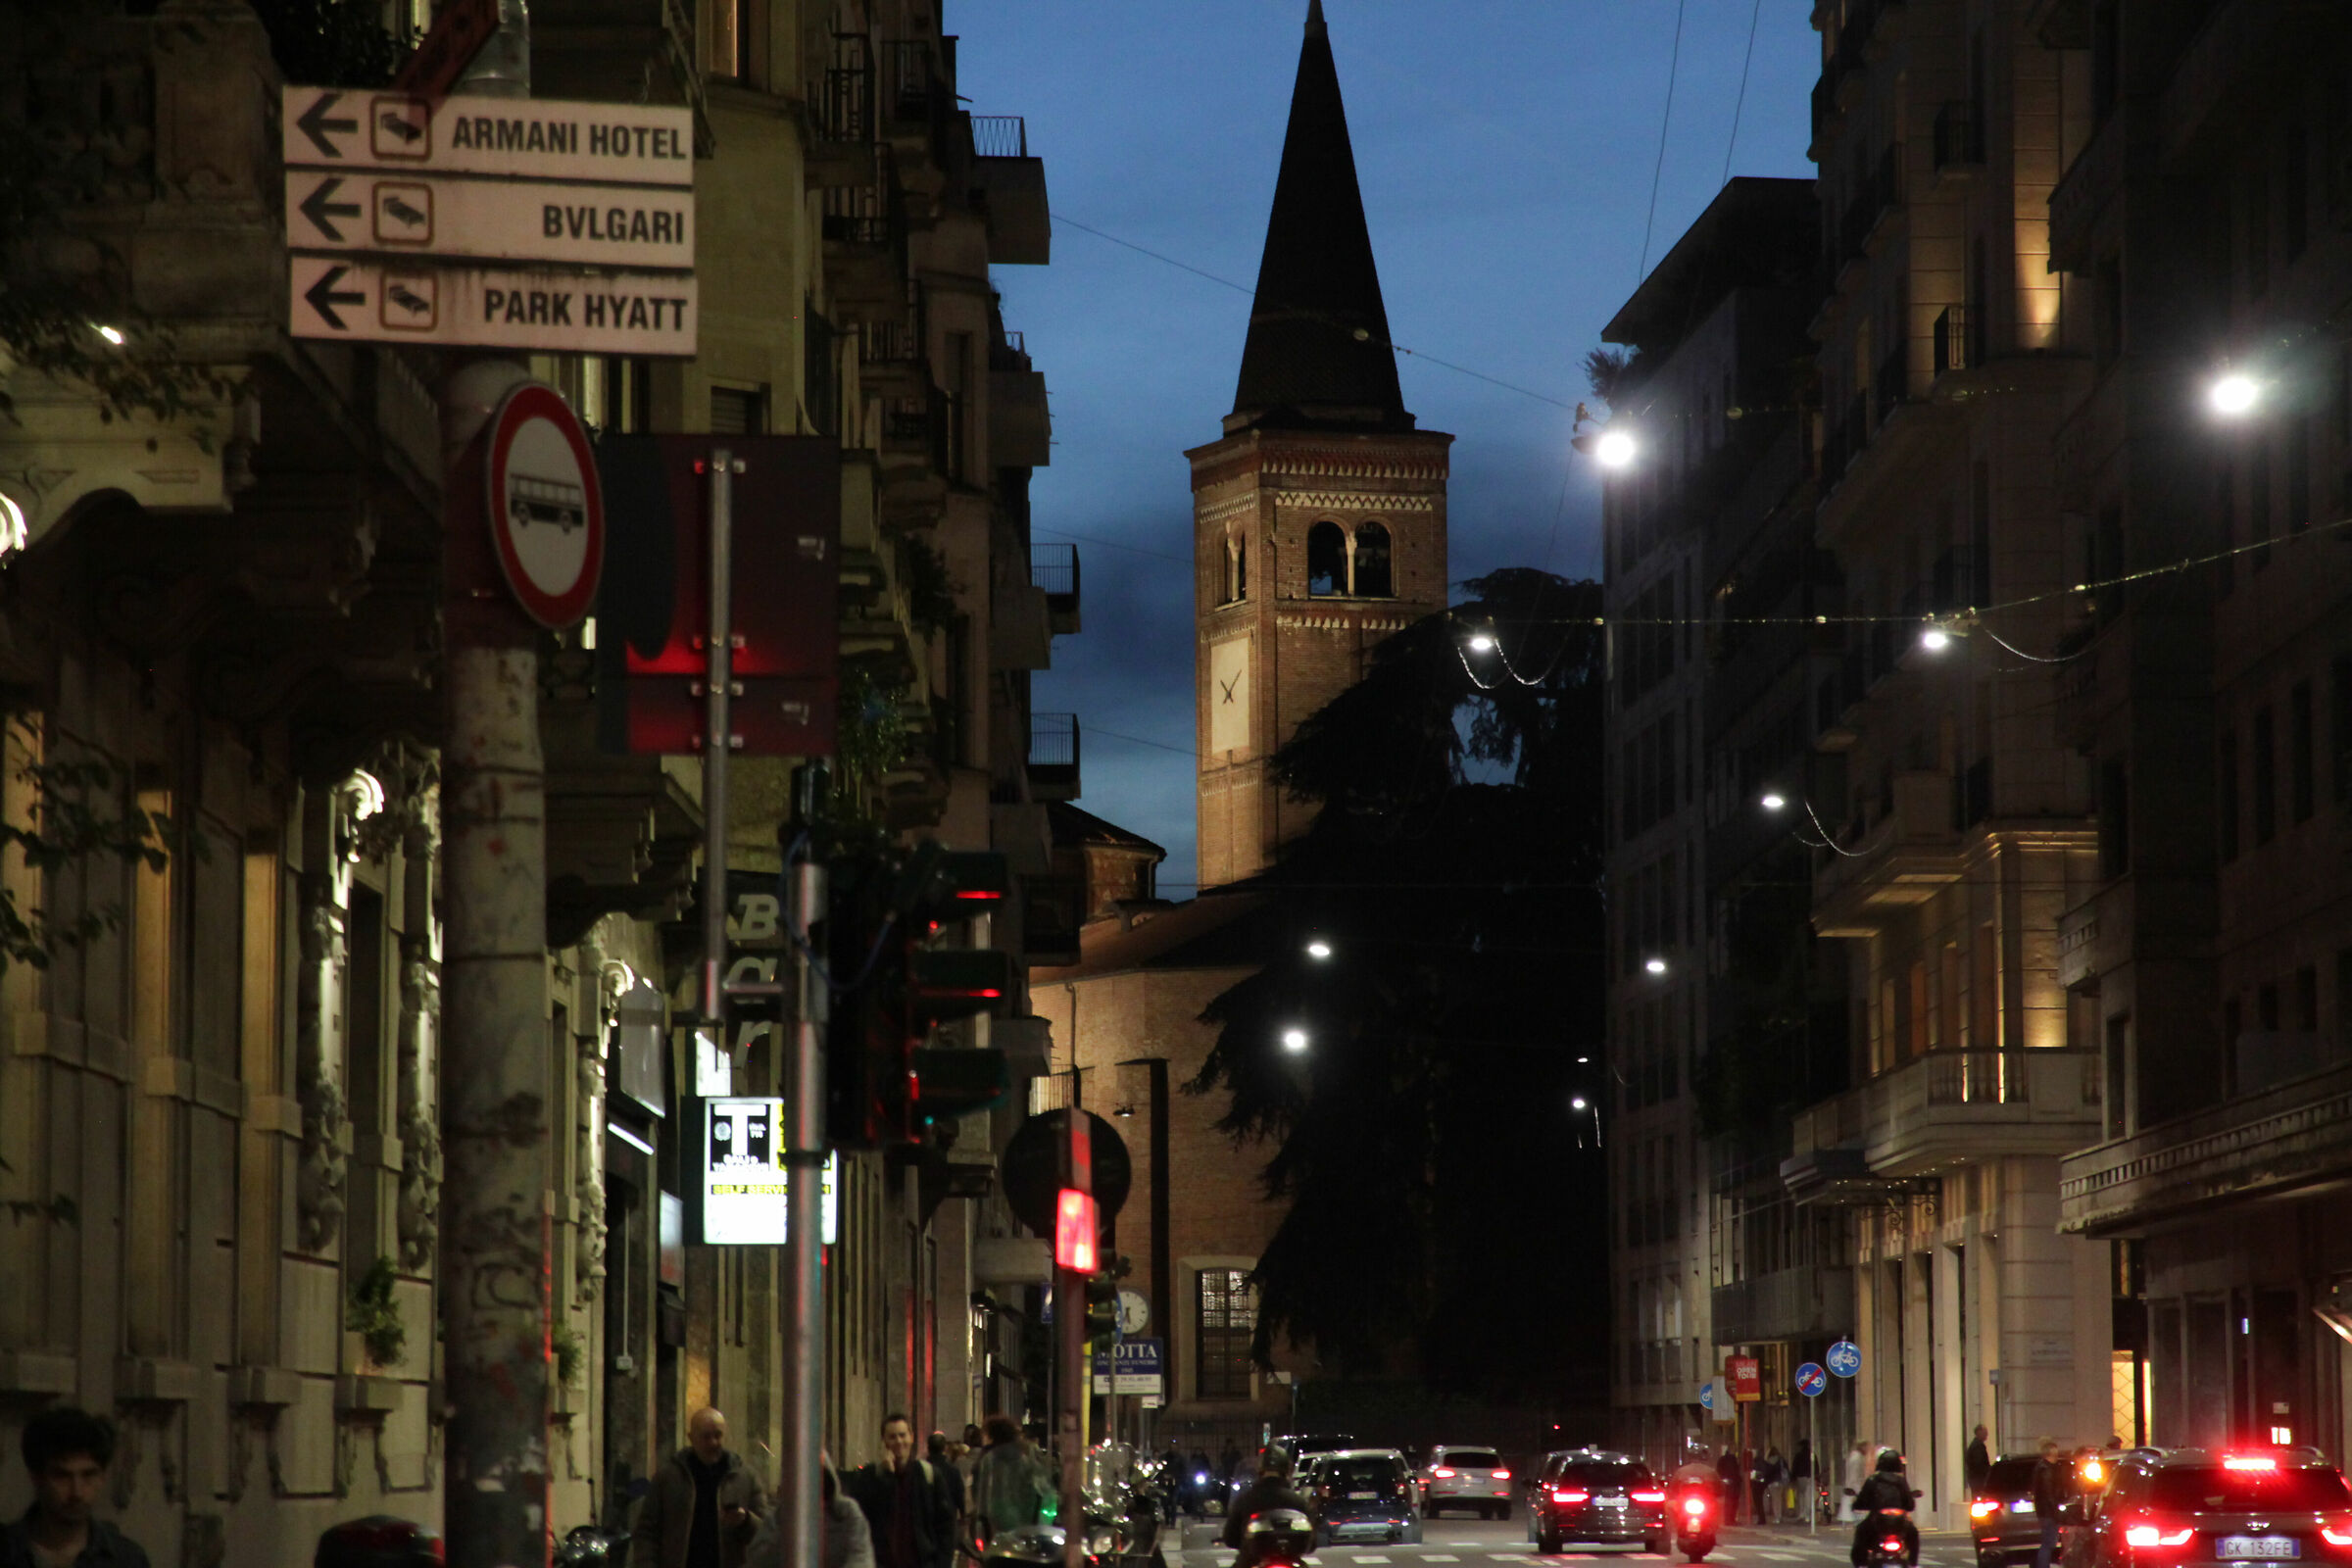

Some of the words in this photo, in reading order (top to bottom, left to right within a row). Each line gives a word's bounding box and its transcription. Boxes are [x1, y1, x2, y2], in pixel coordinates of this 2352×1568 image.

[452, 117, 577, 154] ARMANI
[590, 124, 687, 160] HOTEL
[543, 205, 684, 244] BVLGARI
[484, 289, 572, 326] PARK
[585, 296, 688, 331] HYATT
[712, 1185, 745, 1195] SELF
[747, 1185, 787, 1195] SERVI
[2226, 1542, 2242, 1555] GK
[2250, 1542, 2290, 1555] 132FE
